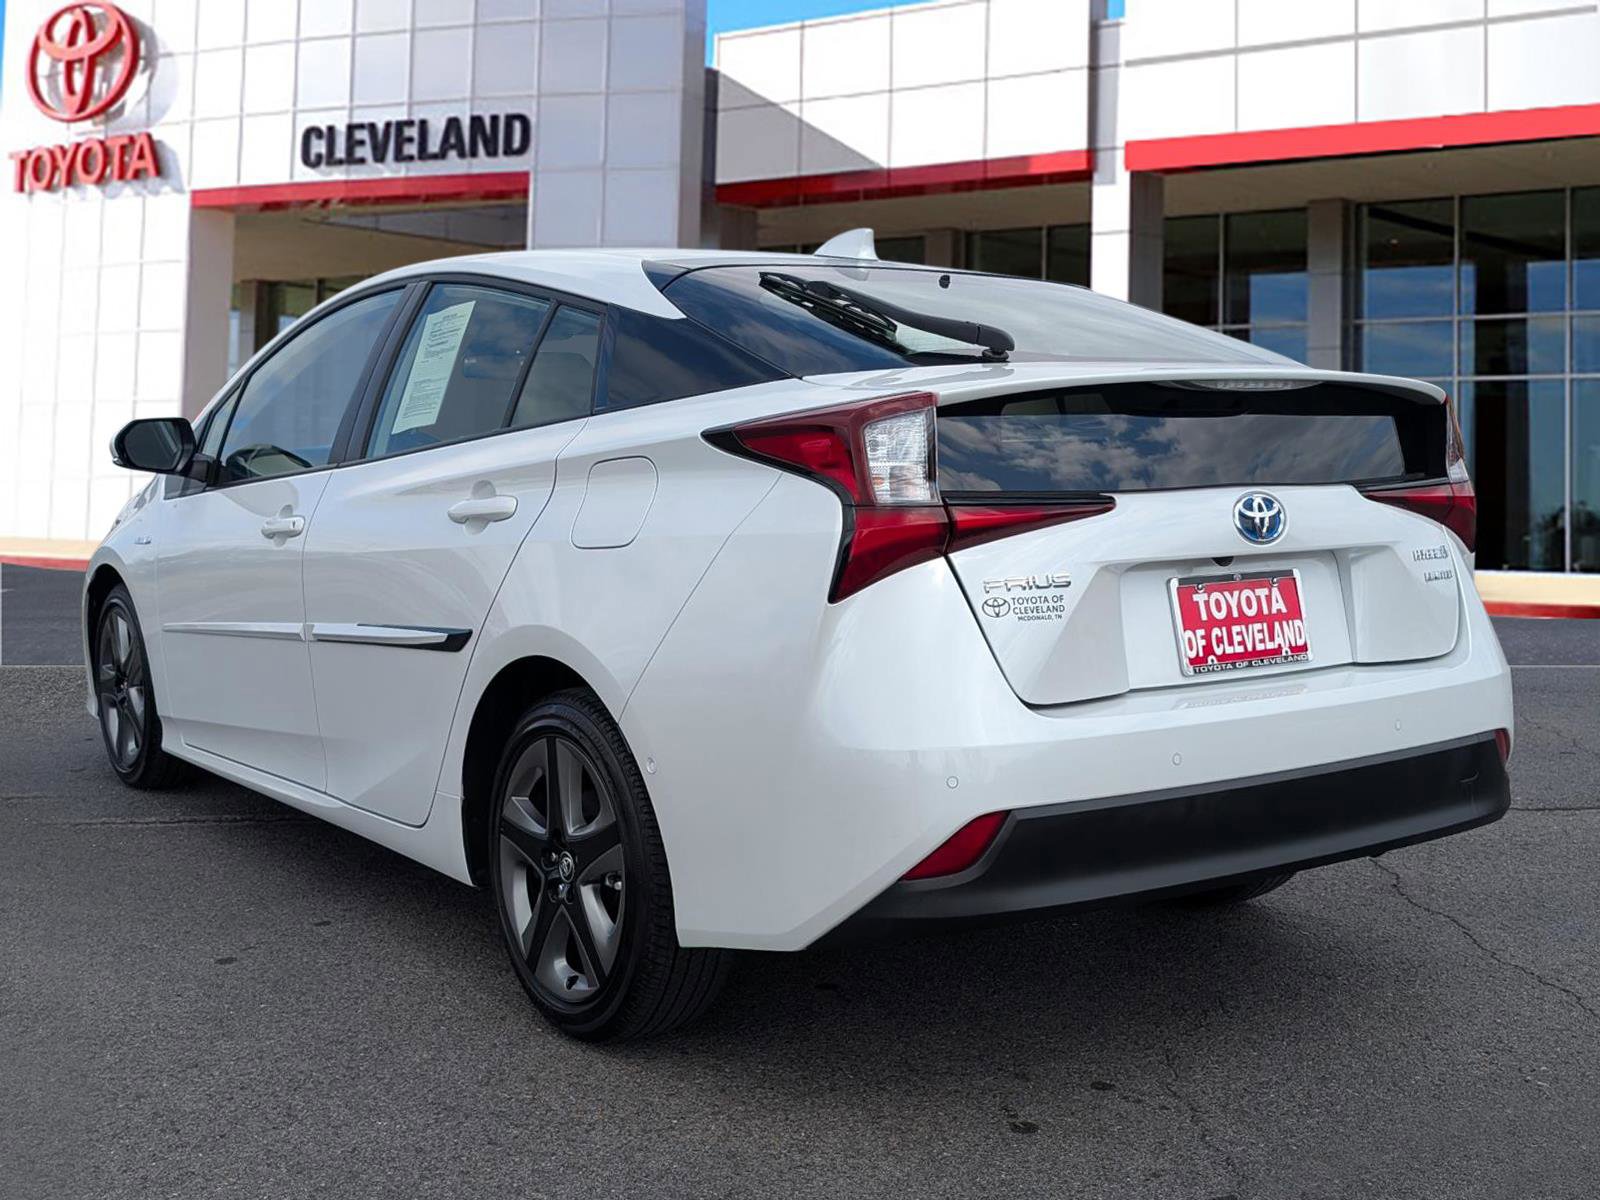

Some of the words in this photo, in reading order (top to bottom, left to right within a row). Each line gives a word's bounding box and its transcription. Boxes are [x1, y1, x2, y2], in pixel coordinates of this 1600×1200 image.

[301, 113, 531, 169] CLEVELAND
[8, 131, 160, 193] TOYOTA
[983, 574, 1072, 594] PRIUS
[1011, 595, 1050, 606] TOYOTA
[1051, 594, 1065, 604] OF
[1012, 604, 1066, 616] CLEVELAND
[1192, 587, 1288, 621] TOYOTA
[1017, 613, 1054, 622] MCDONALD,
[1184, 628, 1207, 659] OF
[1211, 619, 1306, 656] CLEVELAND
[1194, 663, 1234, 674] TOYOTA
[1236, 661, 1249, 669] OF
[1251, 653, 1309, 668] CLEVELAND
